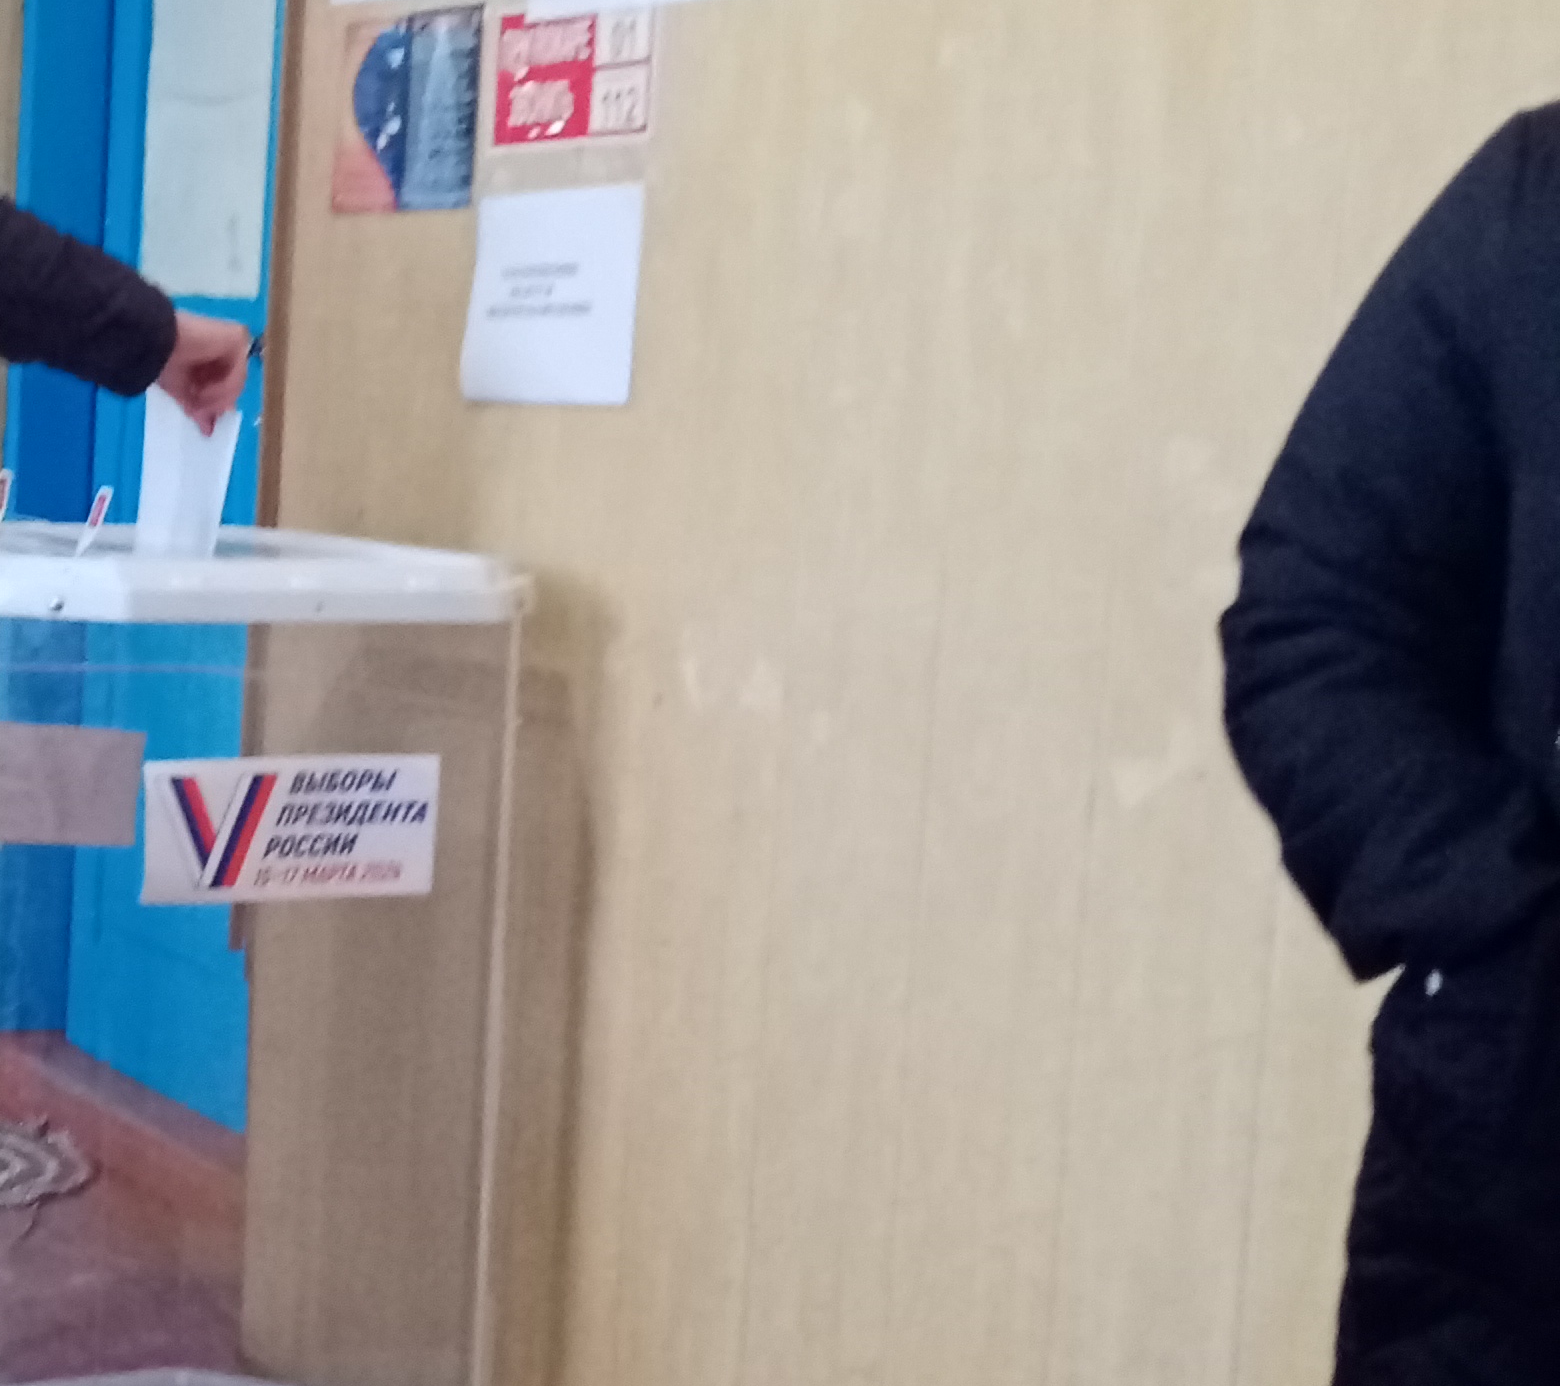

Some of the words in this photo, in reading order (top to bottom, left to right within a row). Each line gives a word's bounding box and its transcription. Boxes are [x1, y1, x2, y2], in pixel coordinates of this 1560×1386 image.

[289, 768, 399, 795] ВЫБОРЫ
[276, 799, 429, 827] ПРЕЗИДЕНТА
[262, 831, 360, 860] РОССИИ
